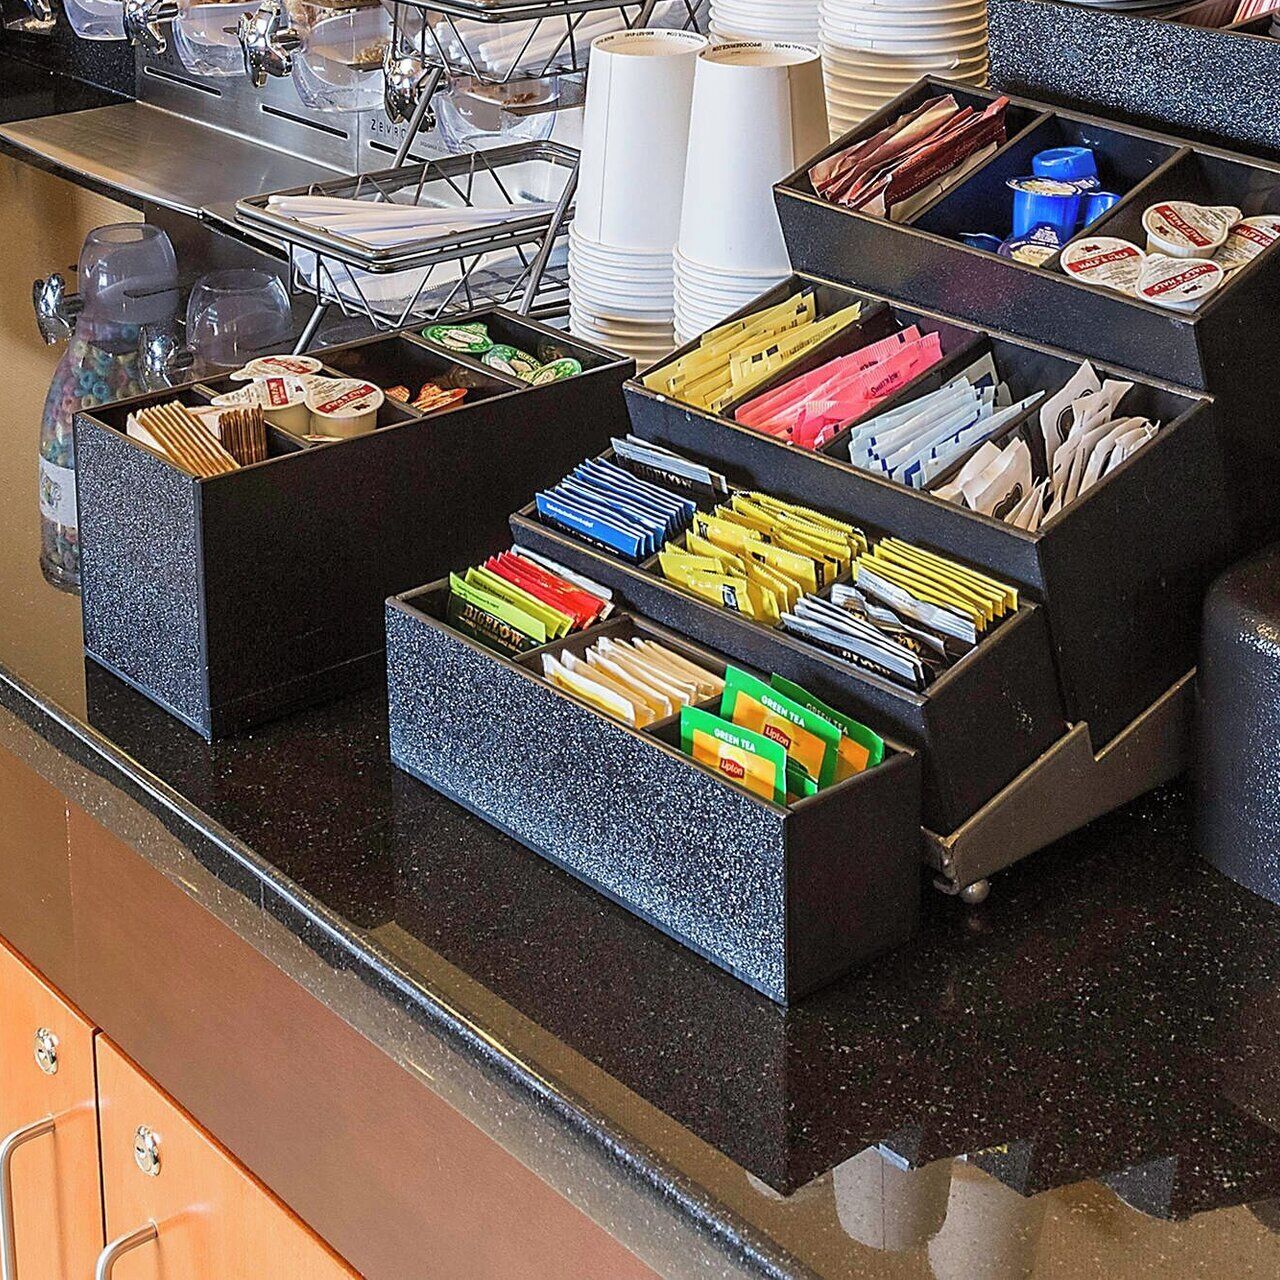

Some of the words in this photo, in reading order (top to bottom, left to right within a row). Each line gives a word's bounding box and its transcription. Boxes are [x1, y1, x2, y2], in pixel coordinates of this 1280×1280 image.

[464, 603, 526, 648] BIGELOW
[761, 694, 789, 717] GREEN
[789, 710, 806, 728] TEA
[713, 727, 740, 746] GREEN
[740, 736, 756, 753] TEA
[765, 725, 790, 747] Lipton
[721, 757, 744, 777] Lipton
